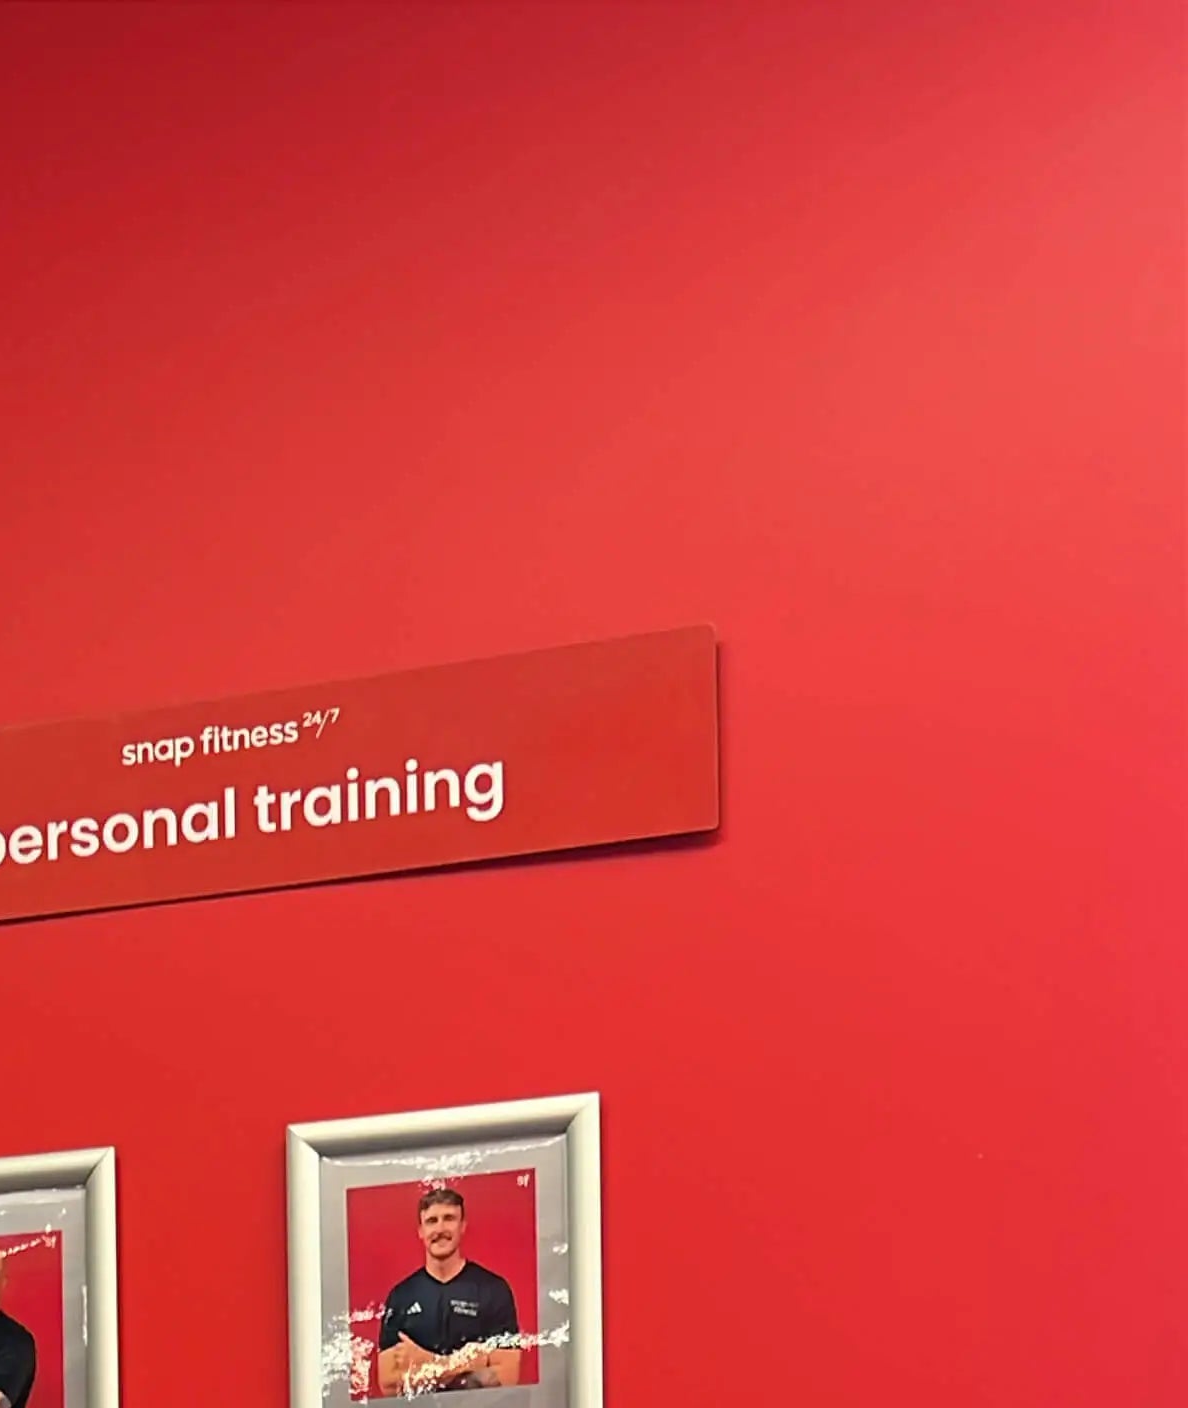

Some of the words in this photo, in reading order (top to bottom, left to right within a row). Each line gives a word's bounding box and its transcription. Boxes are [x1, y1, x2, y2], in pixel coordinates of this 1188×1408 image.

[121, 732, 194, 767] snap
[199, 715, 298, 756] fitness
[303, 707, 340, 739] 24/7
[253, 757, 505, 832] training
